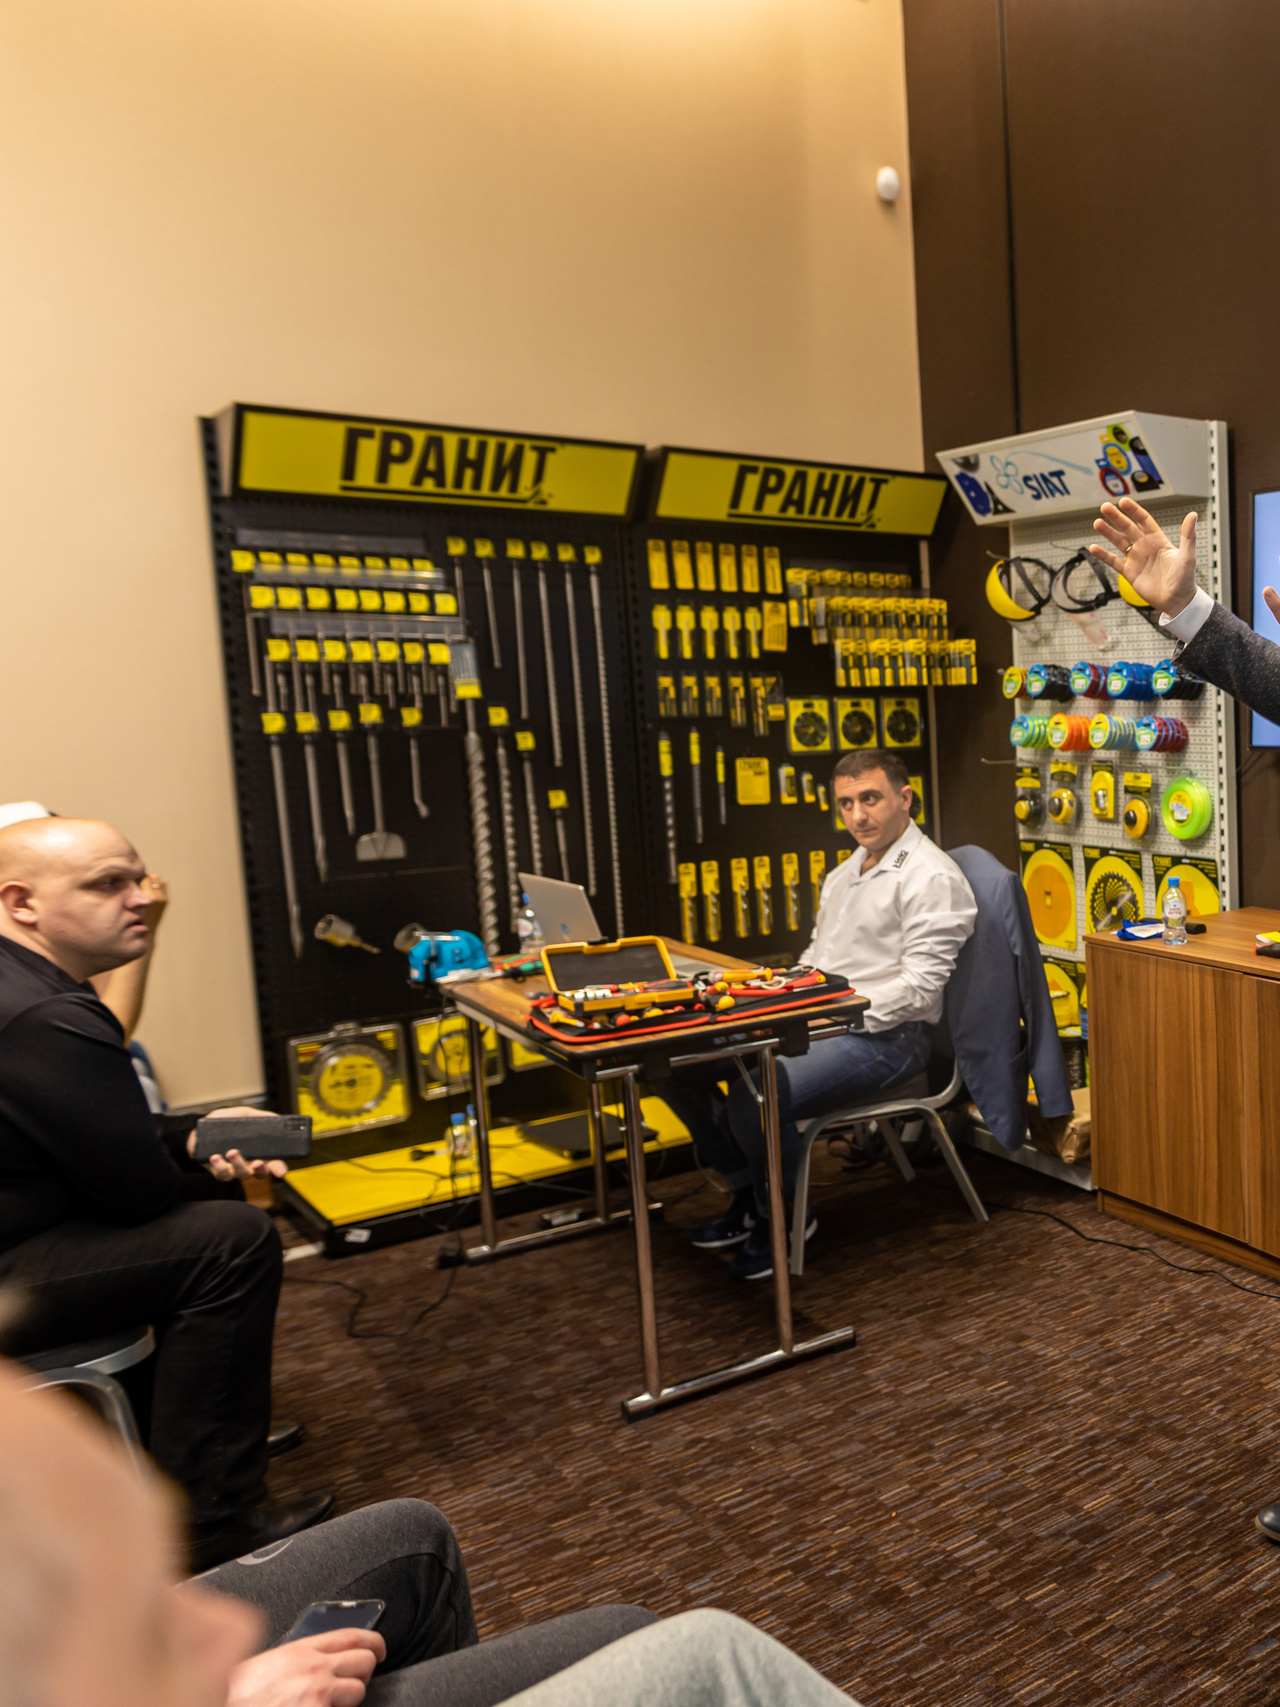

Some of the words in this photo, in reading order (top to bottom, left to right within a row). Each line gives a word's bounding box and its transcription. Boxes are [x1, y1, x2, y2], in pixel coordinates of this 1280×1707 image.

[341, 426, 557, 495] ГРАНИТ
[1023, 469, 1071, 500] SIAT
[728, 464, 890, 519] ГРАНИТ
